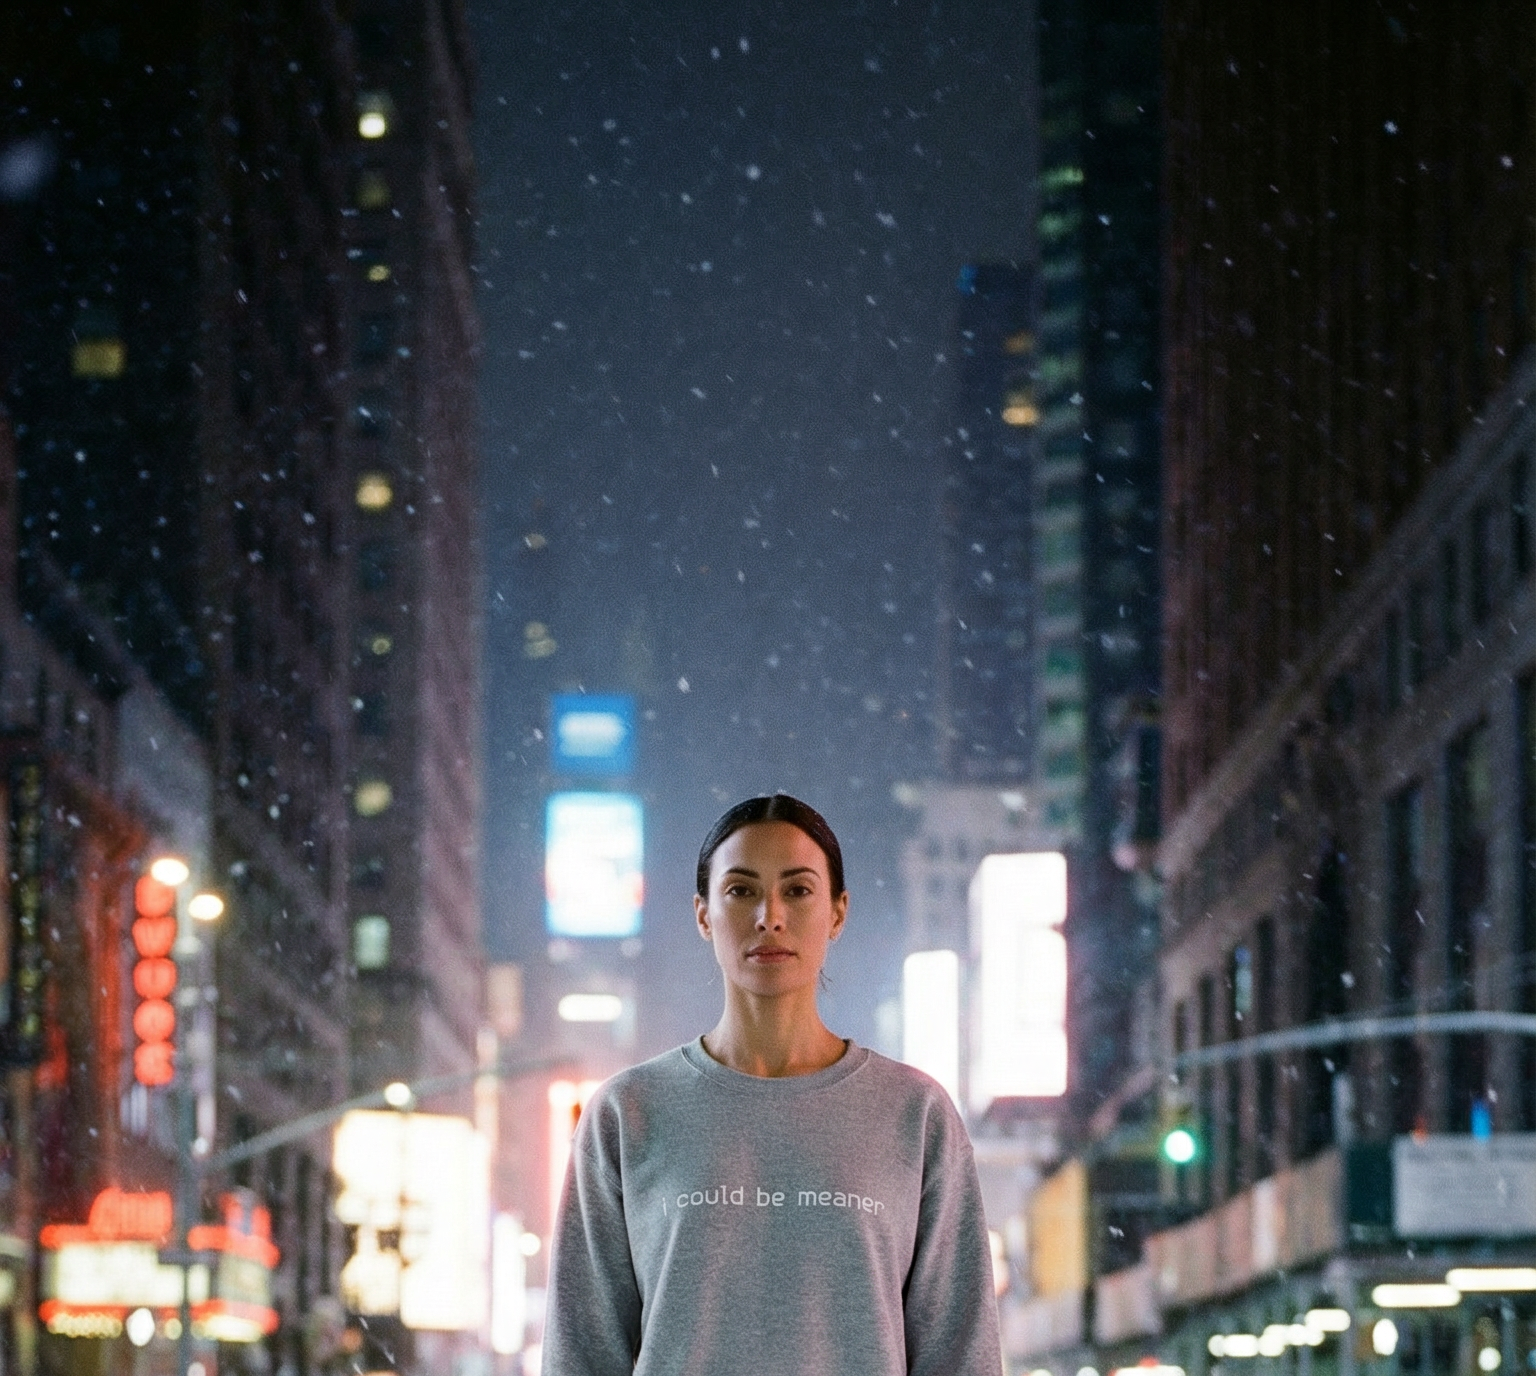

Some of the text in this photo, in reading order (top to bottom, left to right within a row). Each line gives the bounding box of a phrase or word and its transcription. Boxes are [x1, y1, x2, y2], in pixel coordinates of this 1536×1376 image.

[676, 1185, 744, 1209] could
[756, 1186, 786, 1207] be
[797, 1190, 885, 1216] meaner
